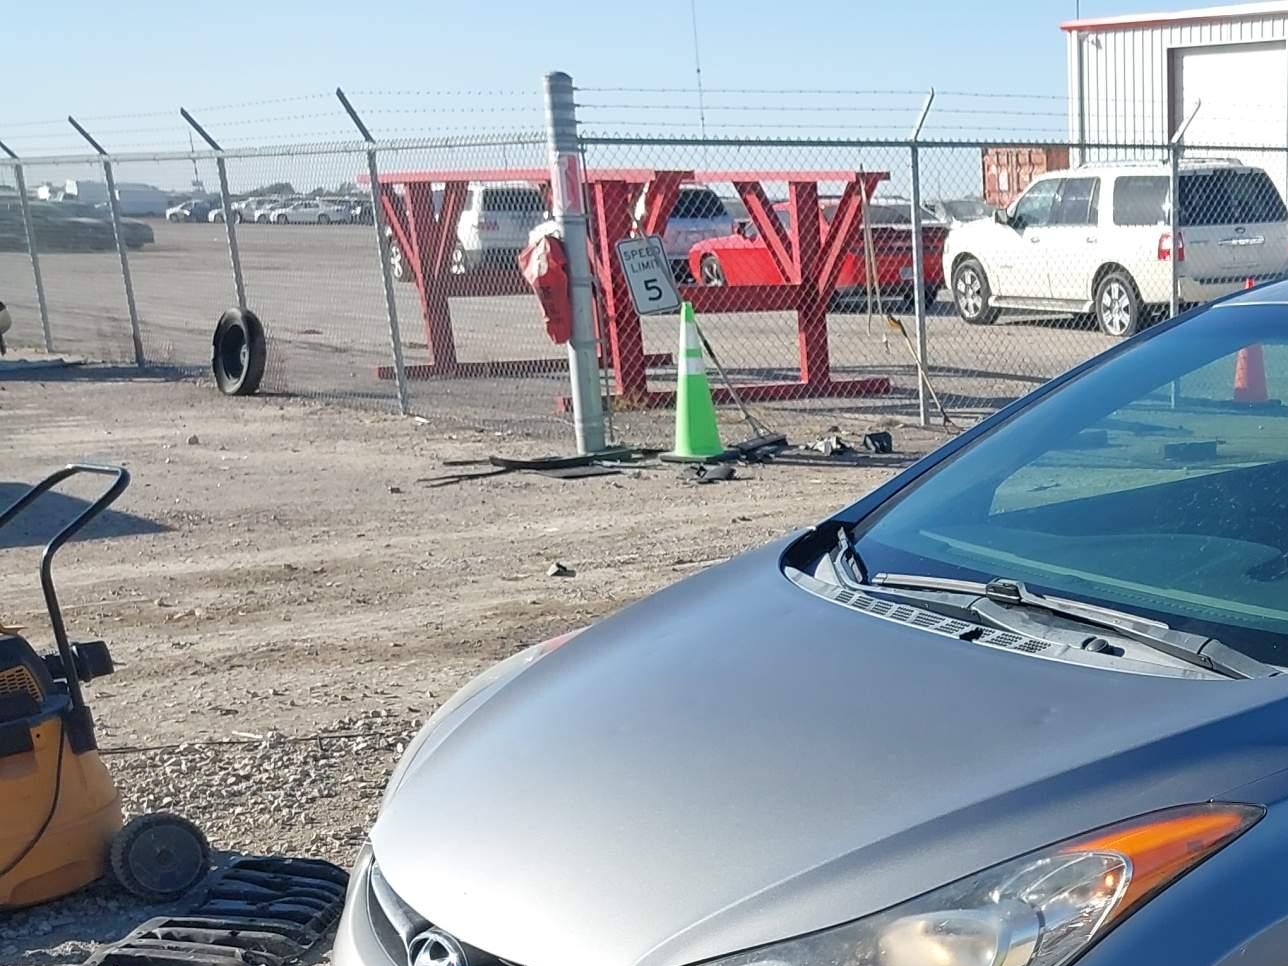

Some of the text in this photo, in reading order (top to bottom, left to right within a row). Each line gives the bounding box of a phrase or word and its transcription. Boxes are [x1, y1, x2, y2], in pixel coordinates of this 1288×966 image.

[623, 247, 661, 261] SPEED
[632, 260, 660, 274] LIMIT
[643, 278, 663, 301] 5
